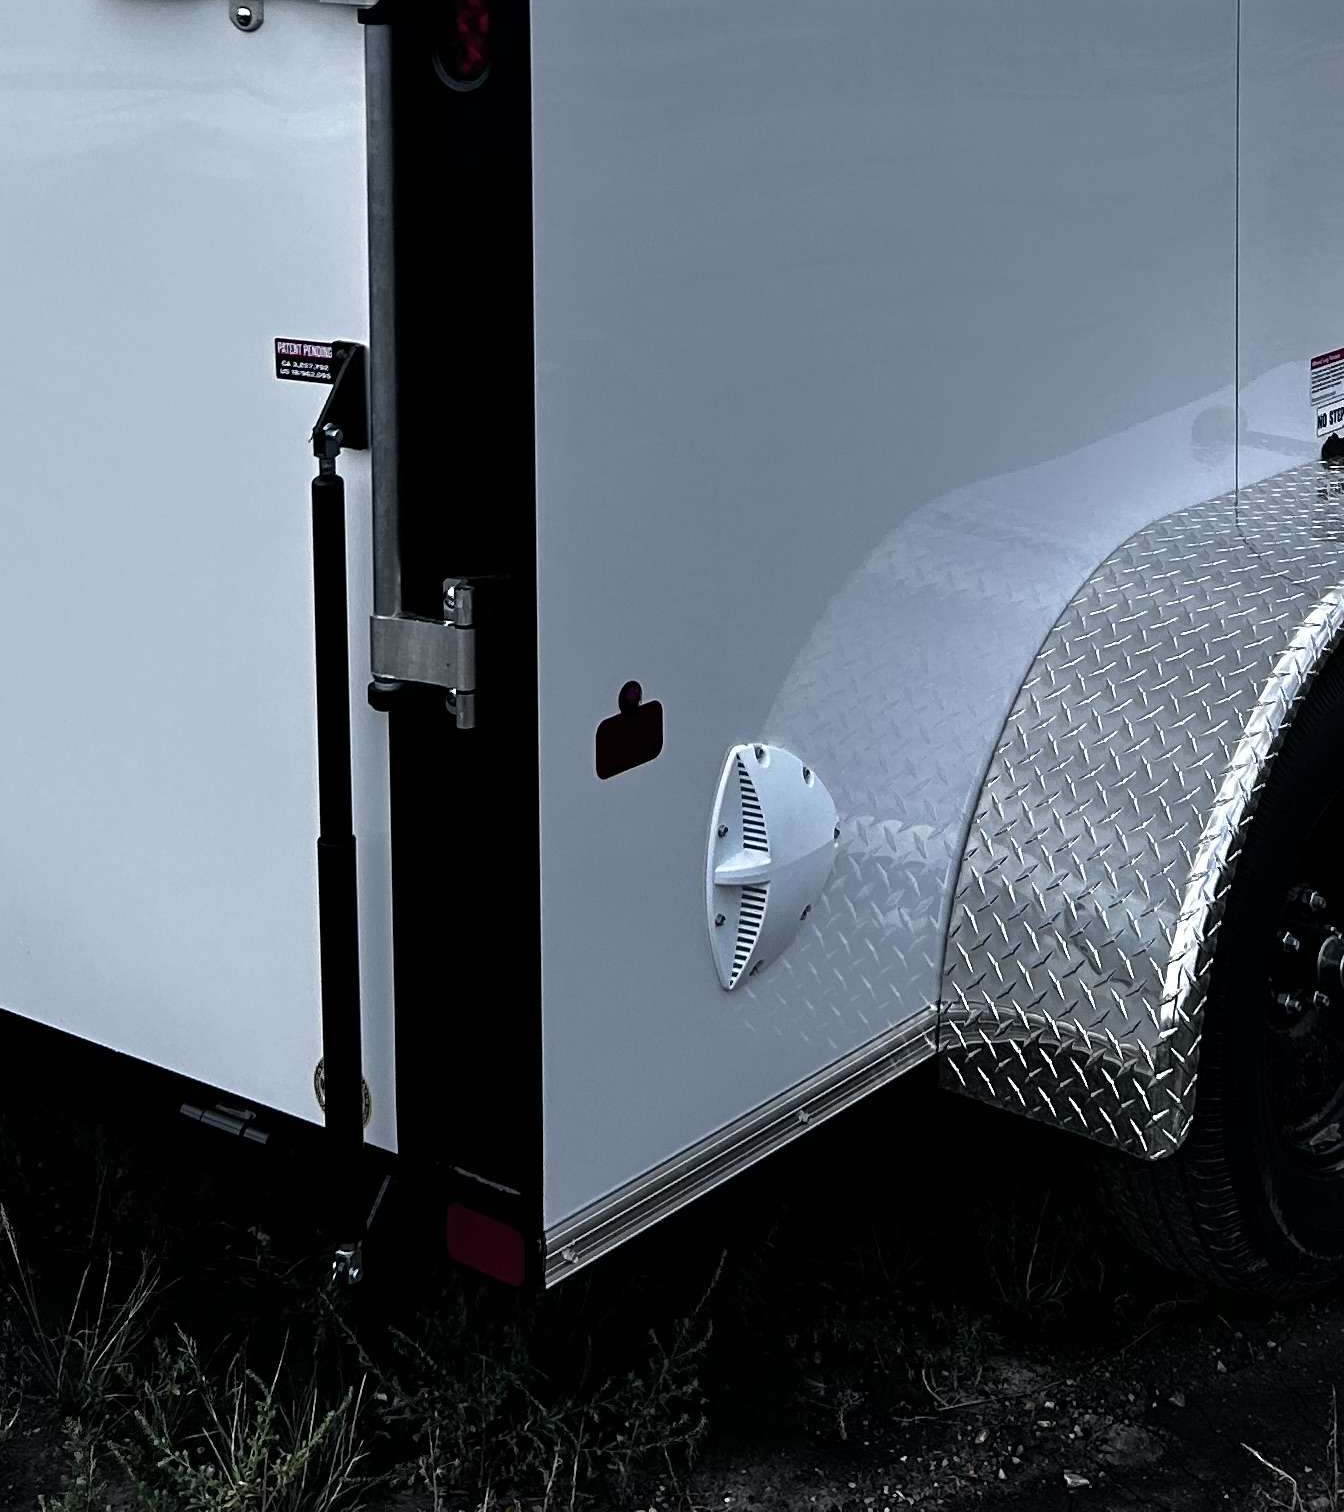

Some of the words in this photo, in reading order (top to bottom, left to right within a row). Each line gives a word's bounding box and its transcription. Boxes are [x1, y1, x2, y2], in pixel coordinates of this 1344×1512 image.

[277, 341, 303, 355] PATENT
[303, 343, 333, 359] PENDING
[1317, 411, 1328, 429] NO
